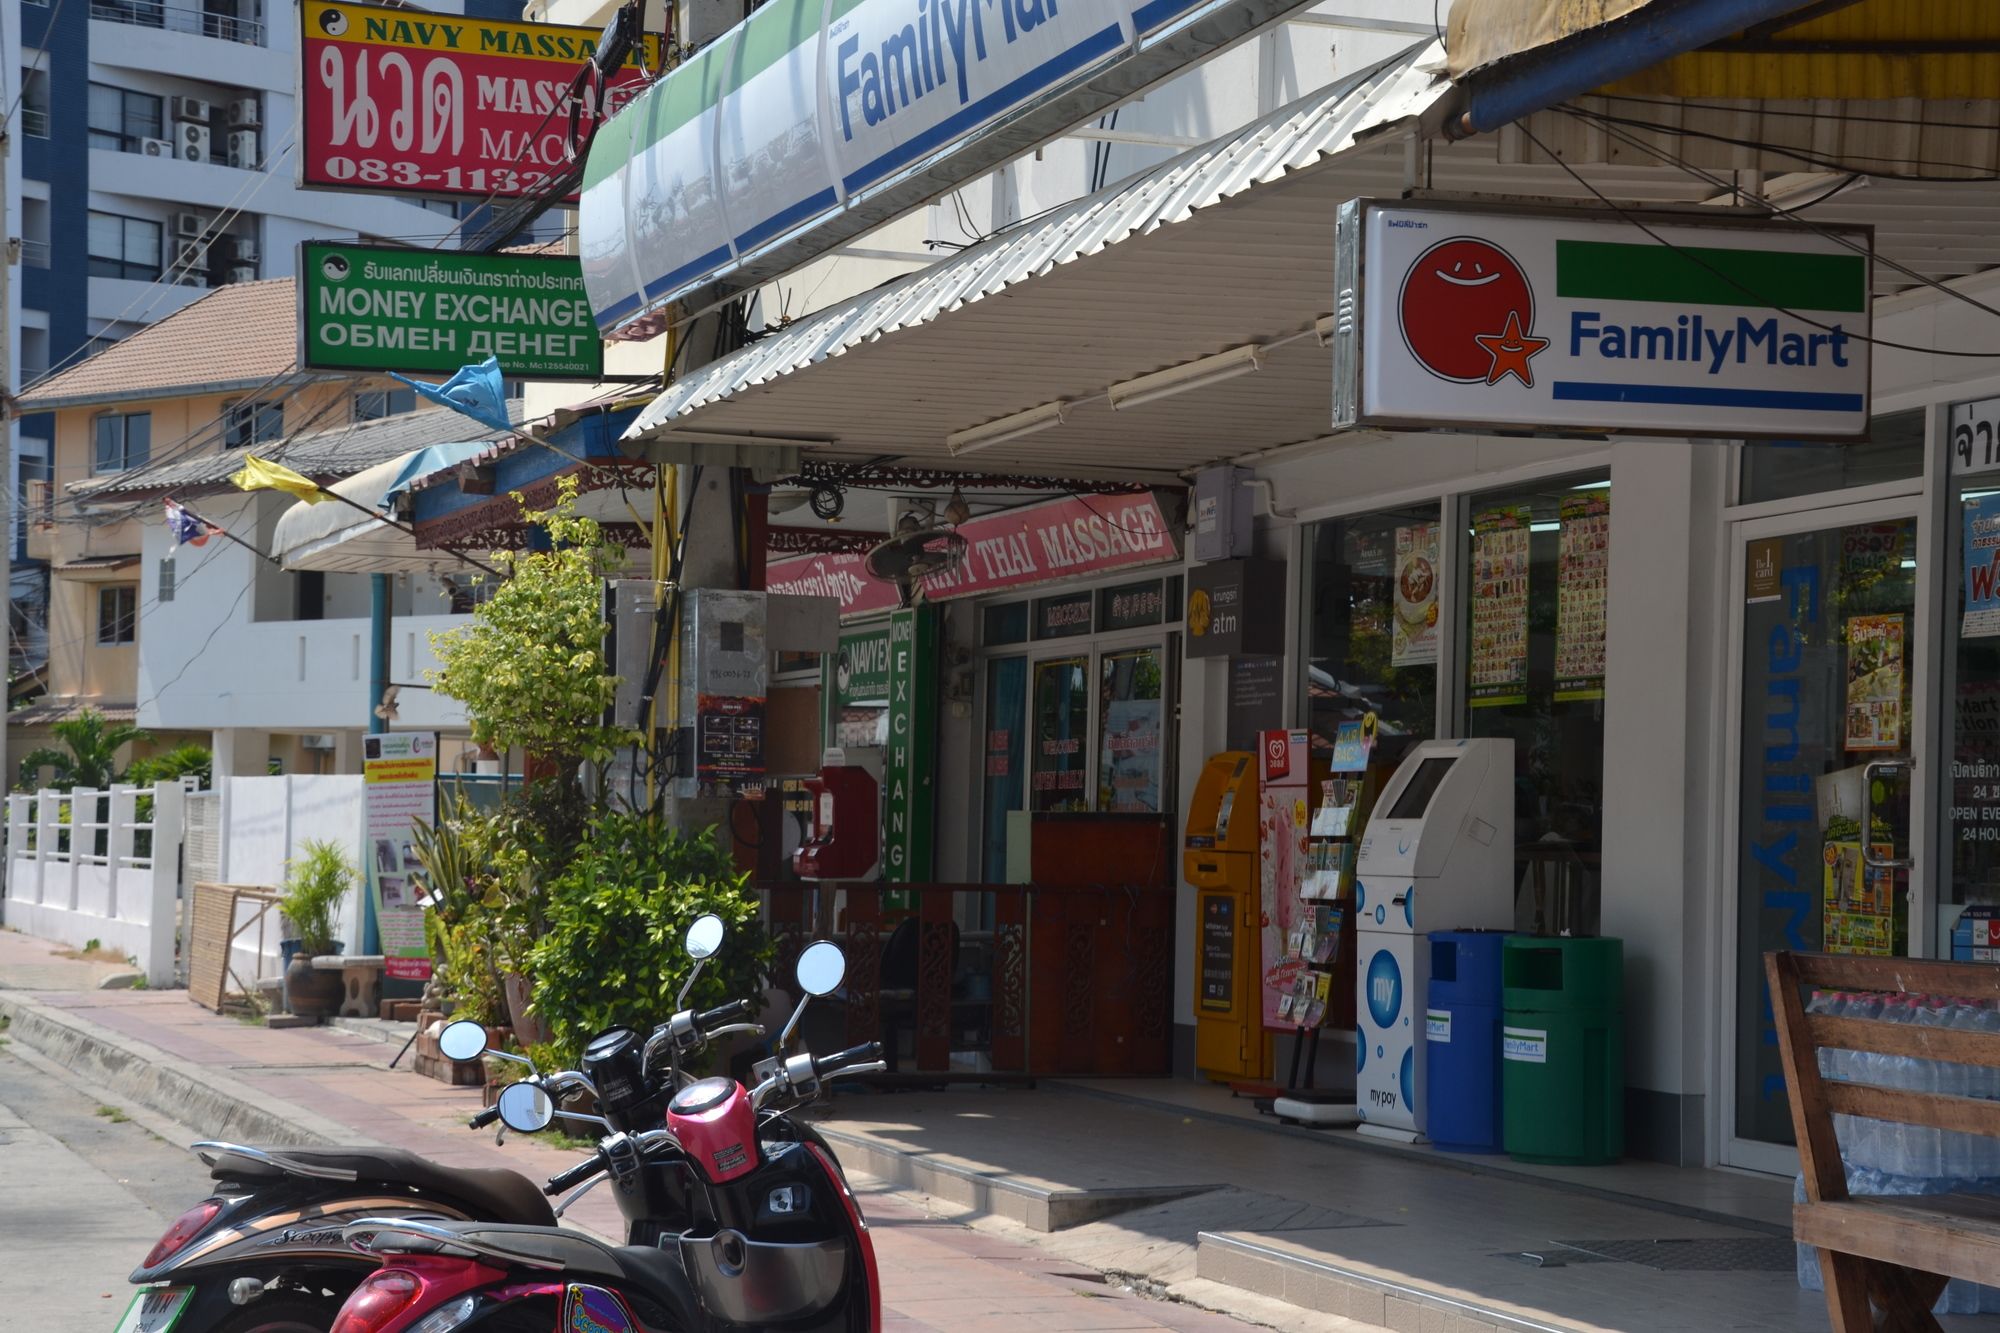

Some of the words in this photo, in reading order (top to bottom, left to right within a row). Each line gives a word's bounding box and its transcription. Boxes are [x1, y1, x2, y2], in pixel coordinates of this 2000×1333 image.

[364, 17, 464, 49] NAVY
[479, 28, 651, 69] MASSAE
[320, 45, 465, 156] นวด
[476, 75, 642, 120] MASSAG
[479, 127, 586, 166] МАСС
[325, 157, 582, 193] 083-1132
[319, 286, 427, 319] MONEY
[435, 294, 587, 327] EXCHANGE
[319, 322, 456, 352] ОБМЕН
[466, 330, 588, 357] ДЕНЕГ
[1569, 311, 1848, 375] FamilyMart
[976, 532, 1037, 577] THAI
[1037, 503, 1164, 569] MASSAGE
[892, 620, 912, 642] MONEY
[1213, 611, 1237, 635] atm
[851, 641, 878, 675] NAVY
[890, 651, 908, 899] EXCHANGE
[1972, 785, 1987, 798] 24
[1948, 807, 1978, 821] OPEN
[1962, 829, 1976, 842] 24
[1373, 977, 1395, 1012] my
[1382, 1090, 1396, 1110] pay
